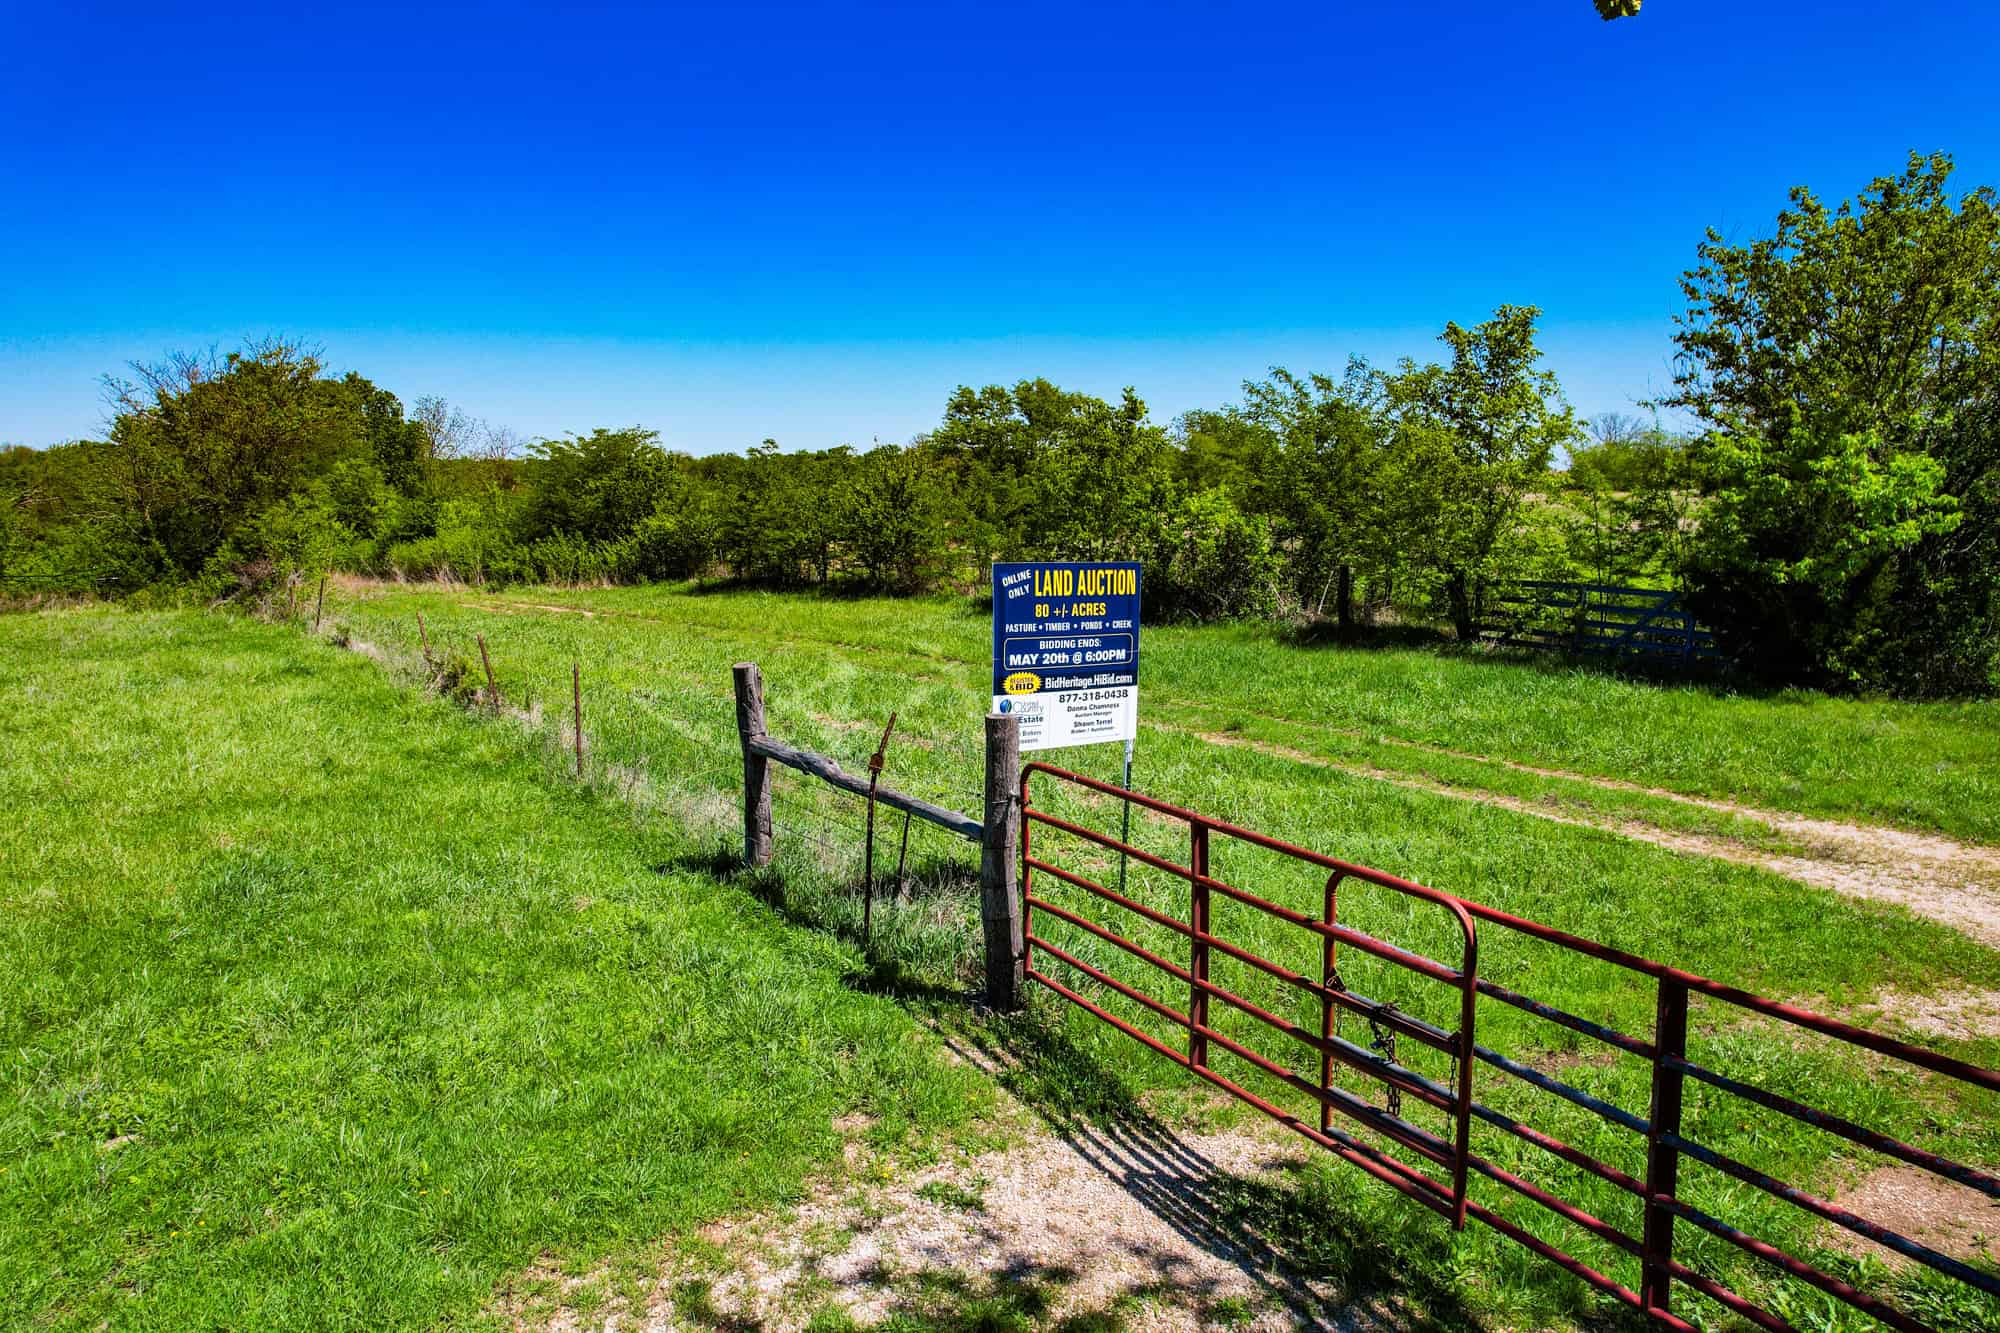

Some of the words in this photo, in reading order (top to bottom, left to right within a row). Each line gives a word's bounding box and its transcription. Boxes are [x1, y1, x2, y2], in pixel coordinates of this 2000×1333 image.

[1002, 569, 1031, 587] ONLINE
[1034, 569, 1073, 597] LAND
[1077, 569, 1136, 596] AUCTION
[1008, 584, 1030, 599] ONLY
[1035, 603, 1049, 618] 80
[1053, 604, 1068, 618] +/-
[1071, 602, 1106, 617] ACRES
[1005, 623, 1036, 633] PASTURE
[1045, 622, 1071, 631] TIMBER
[1080, 621, 1103, 630] PONDS
[1112, 619, 1133, 629] CREEK
[1039, 640, 1076, 649] BIDDING
[1077, 638, 1102, 648] ENDS:
[1009, 653, 1039, 666] MAY
[1042, 652, 1069, 665] 20th
[1072, 652, 1083, 664] @
[1085, 649, 1126, 662] 6:00PM
[1045, 674, 1133, 689] BidHeritage.HiBid.com
[1058, 689, 1129, 703] 877-318-0438
